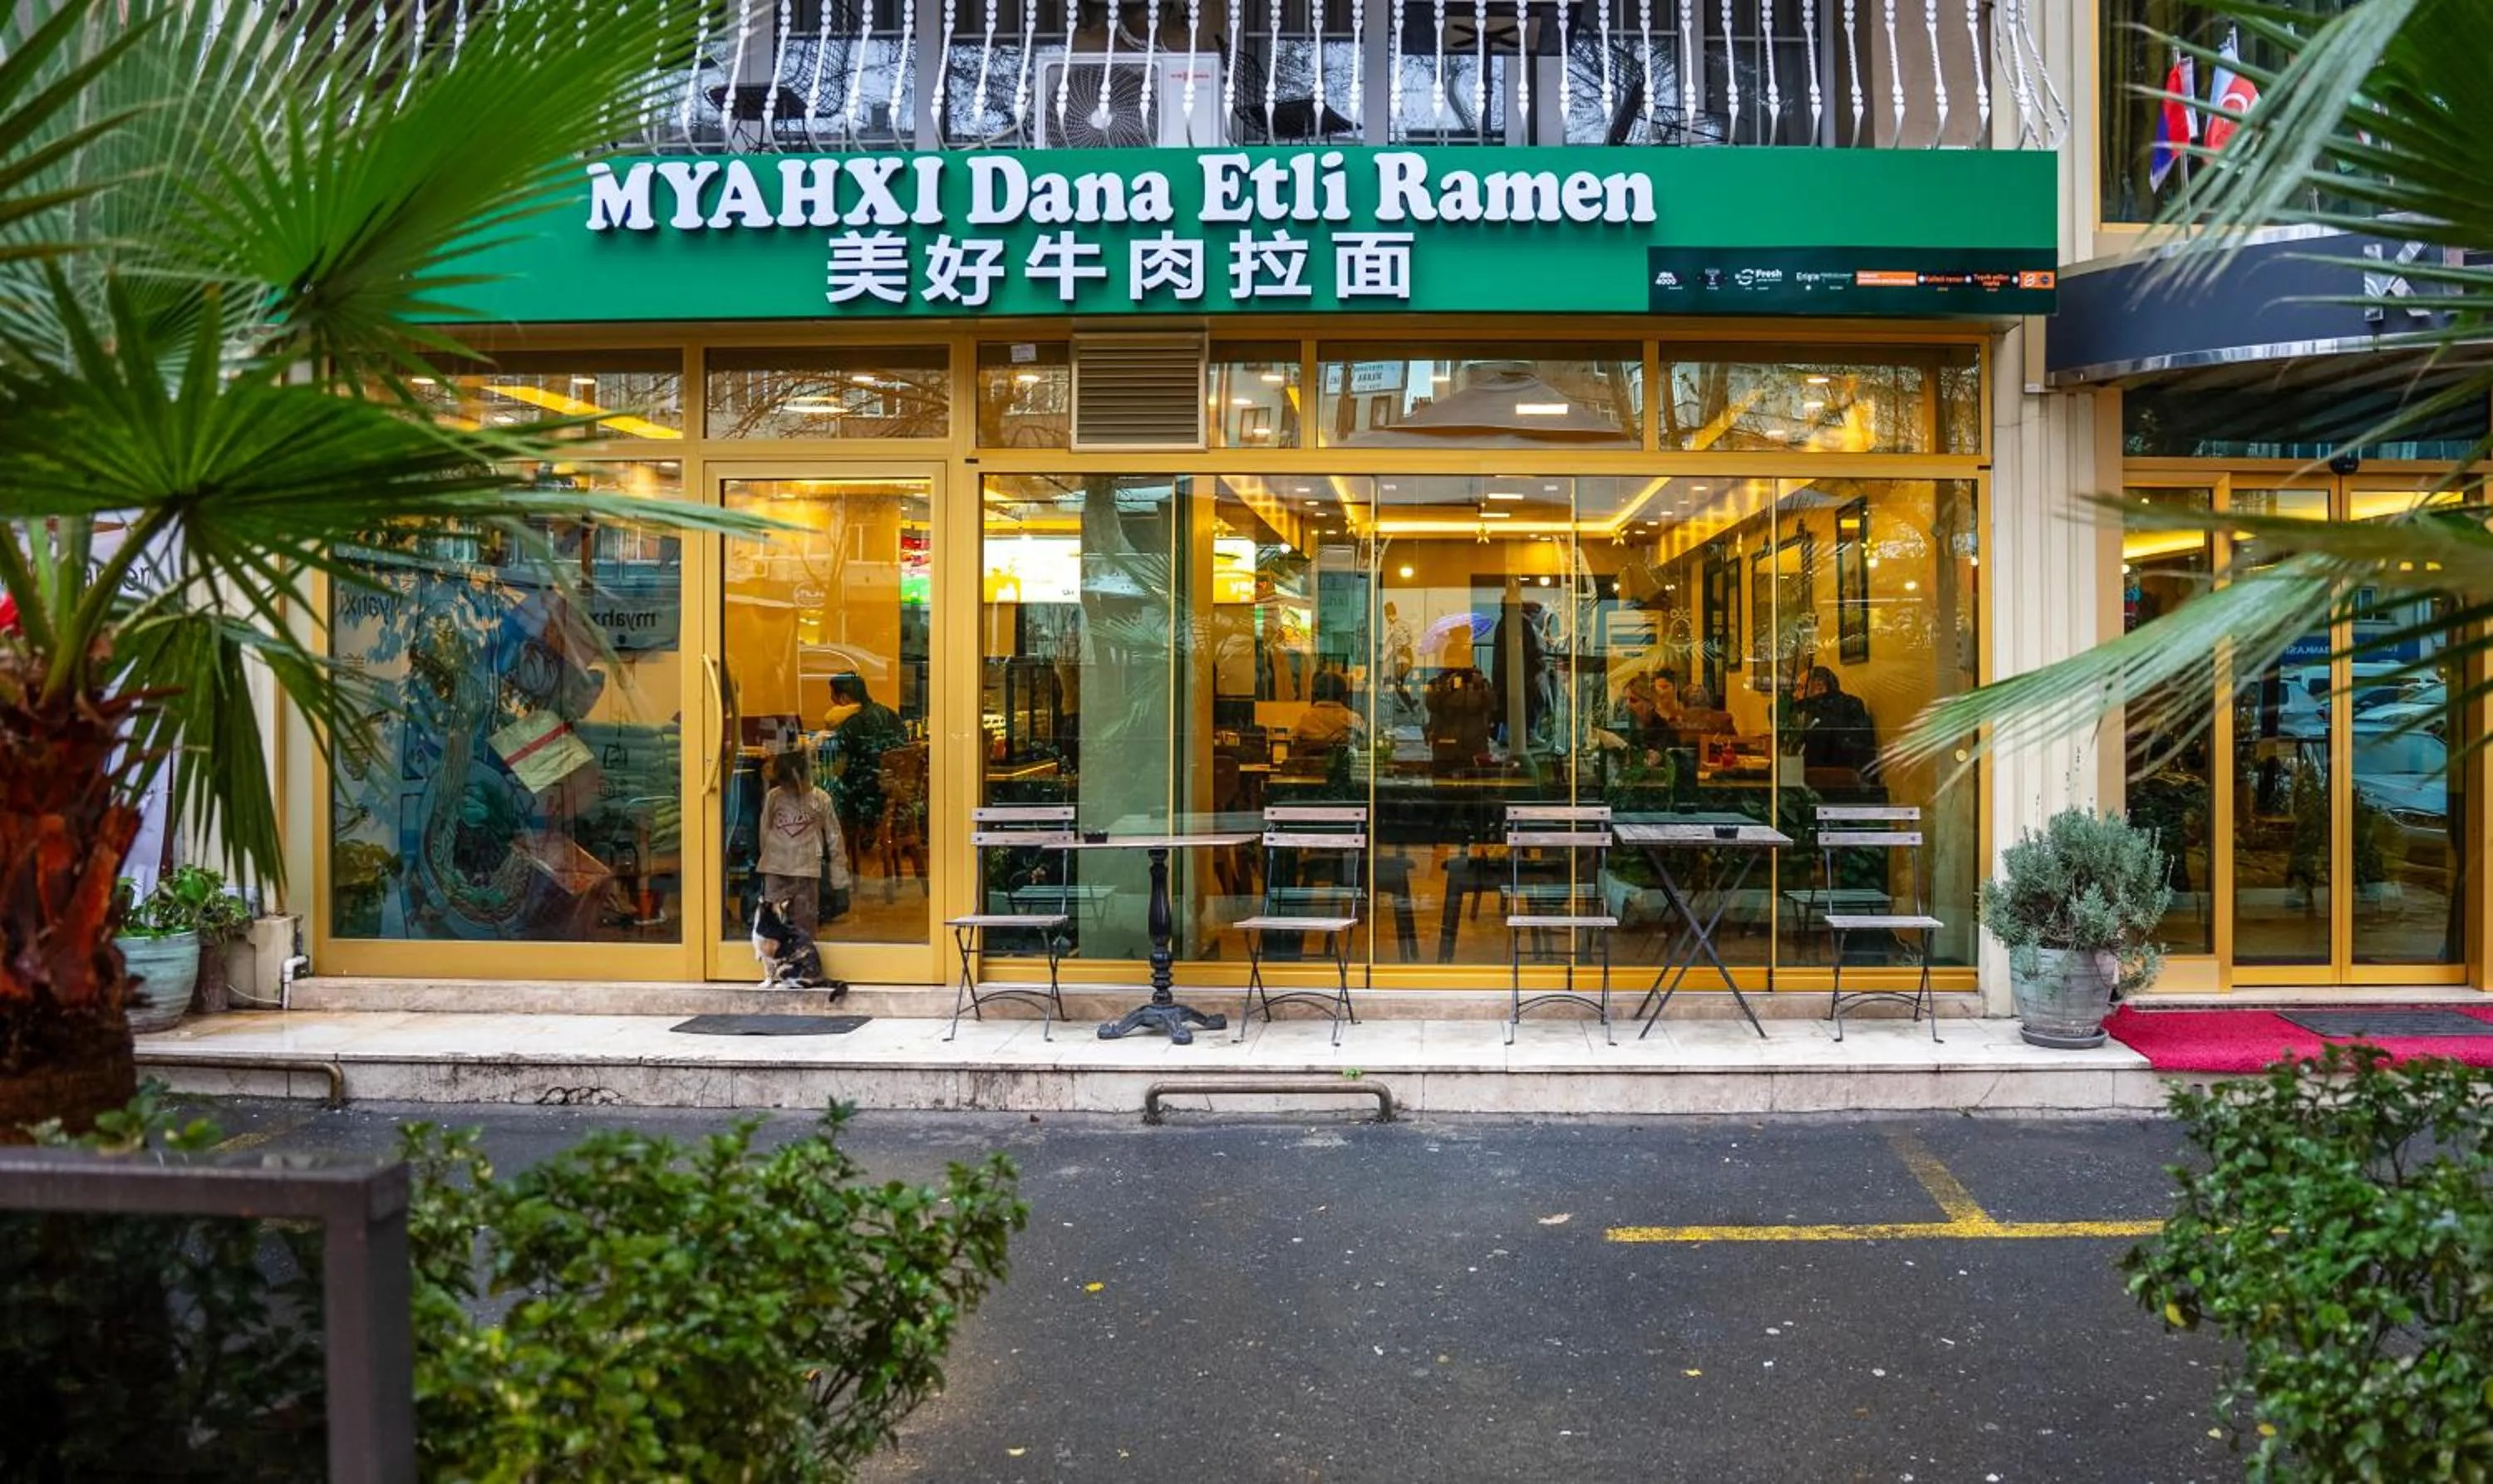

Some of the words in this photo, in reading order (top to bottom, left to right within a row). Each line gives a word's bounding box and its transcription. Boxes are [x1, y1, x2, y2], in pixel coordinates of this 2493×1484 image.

[586, 156, 944, 230] MYAHXI
[966, 155, 1174, 224] Dana
[1197, 151, 1350, 221] Etli
[1374, 151, 1656, 223] Ramen
[825, 228, 1414, 306] 美好牛肉拉面
[1755, 268, 1782, 278] Fresh
